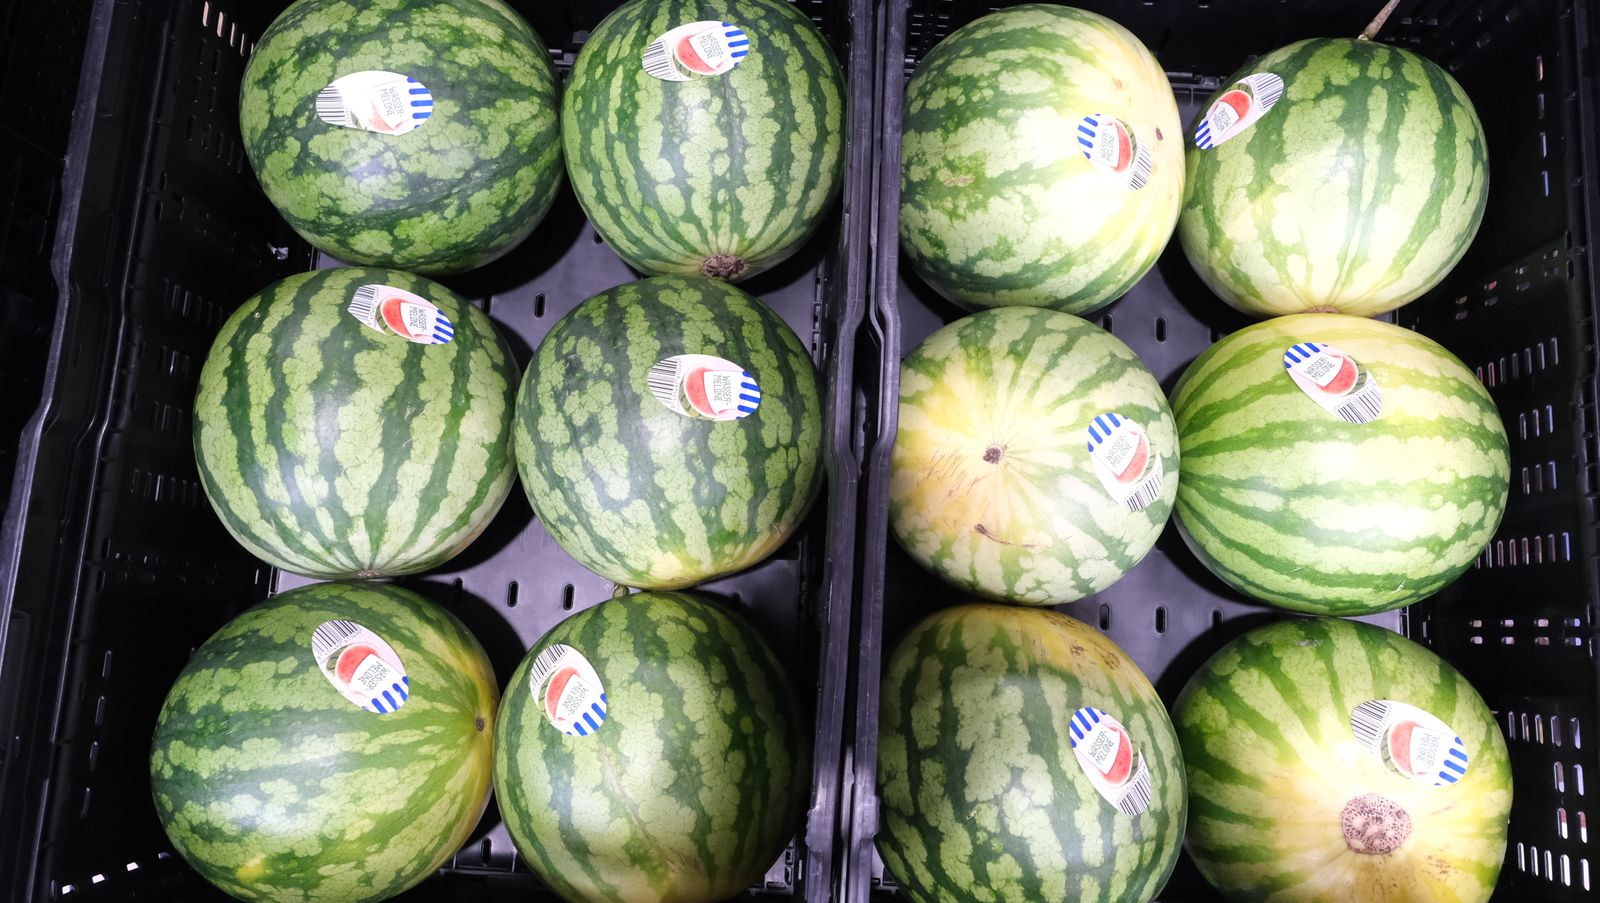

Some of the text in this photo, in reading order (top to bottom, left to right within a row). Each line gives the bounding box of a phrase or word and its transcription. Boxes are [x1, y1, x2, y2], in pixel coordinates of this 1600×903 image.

[1304, 357, 1328, 377] WASSER-
[1312, 363, 1336, 381] MELONE
[713, 374, 723, 403] MELONE
[722, 375, 732, 407] WASSER-
[1110, 443, 1132, 468] MELONE
[357, 660, 384, 686] MELONE
[364, 668, 391, 691] WASSER-
[562, 681, 583, 709] MELONE
[567, 687, 588, 717] WASSER-
[1088, 730, 1108, 758] WASSER-
[1095, 737, 1115, 766] MELONE
